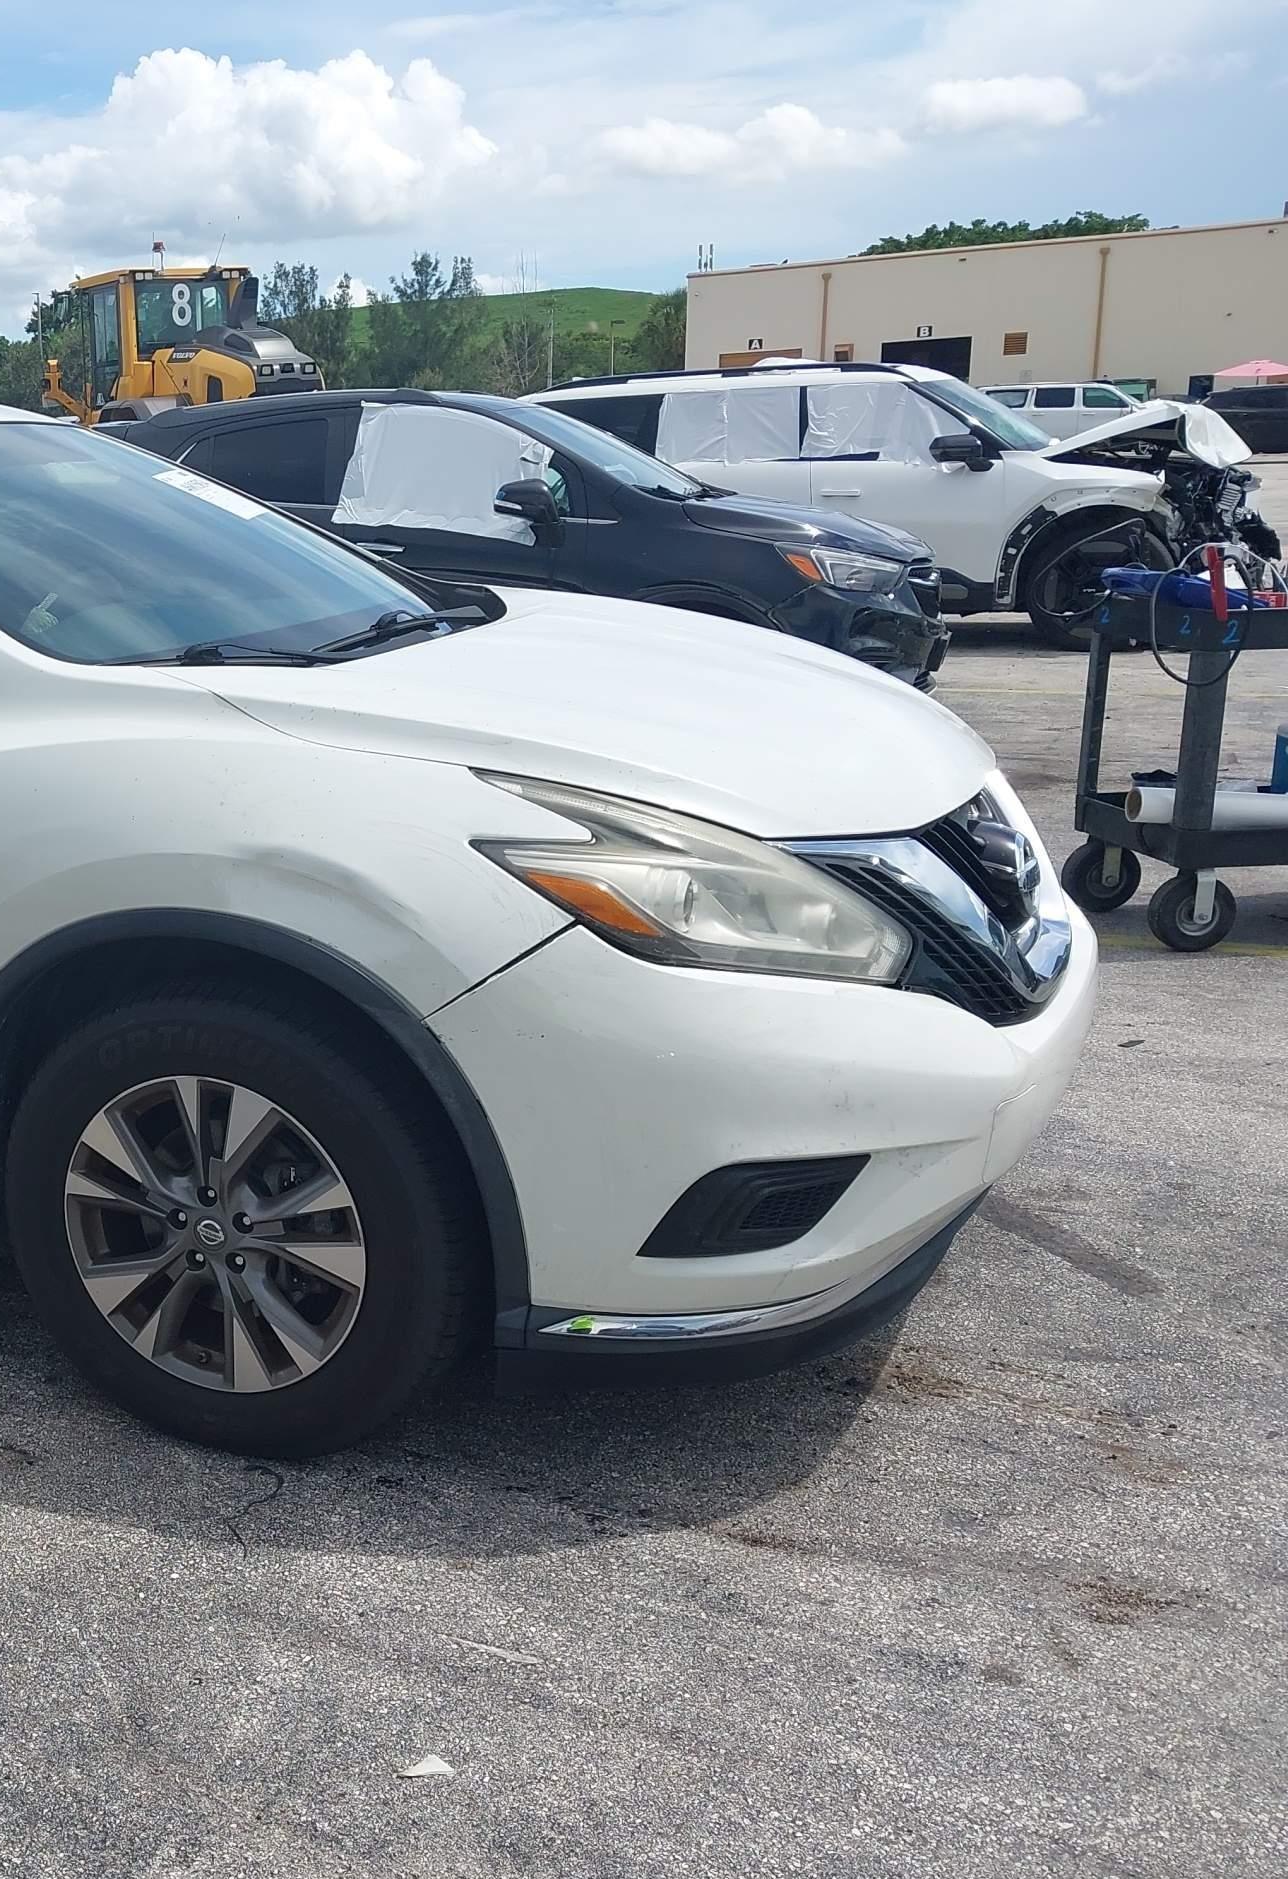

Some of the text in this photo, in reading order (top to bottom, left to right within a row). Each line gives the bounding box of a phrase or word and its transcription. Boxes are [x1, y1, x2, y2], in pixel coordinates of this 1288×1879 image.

[172, 283, 192, 327] 8
[919, 326, 930, 337] B
[750, 339, 761, 350] A
[1100, 608, 1110, 624] 2
[1179, 615, 1191, 634] 2
[1222, 619, 1240, 644] 2
